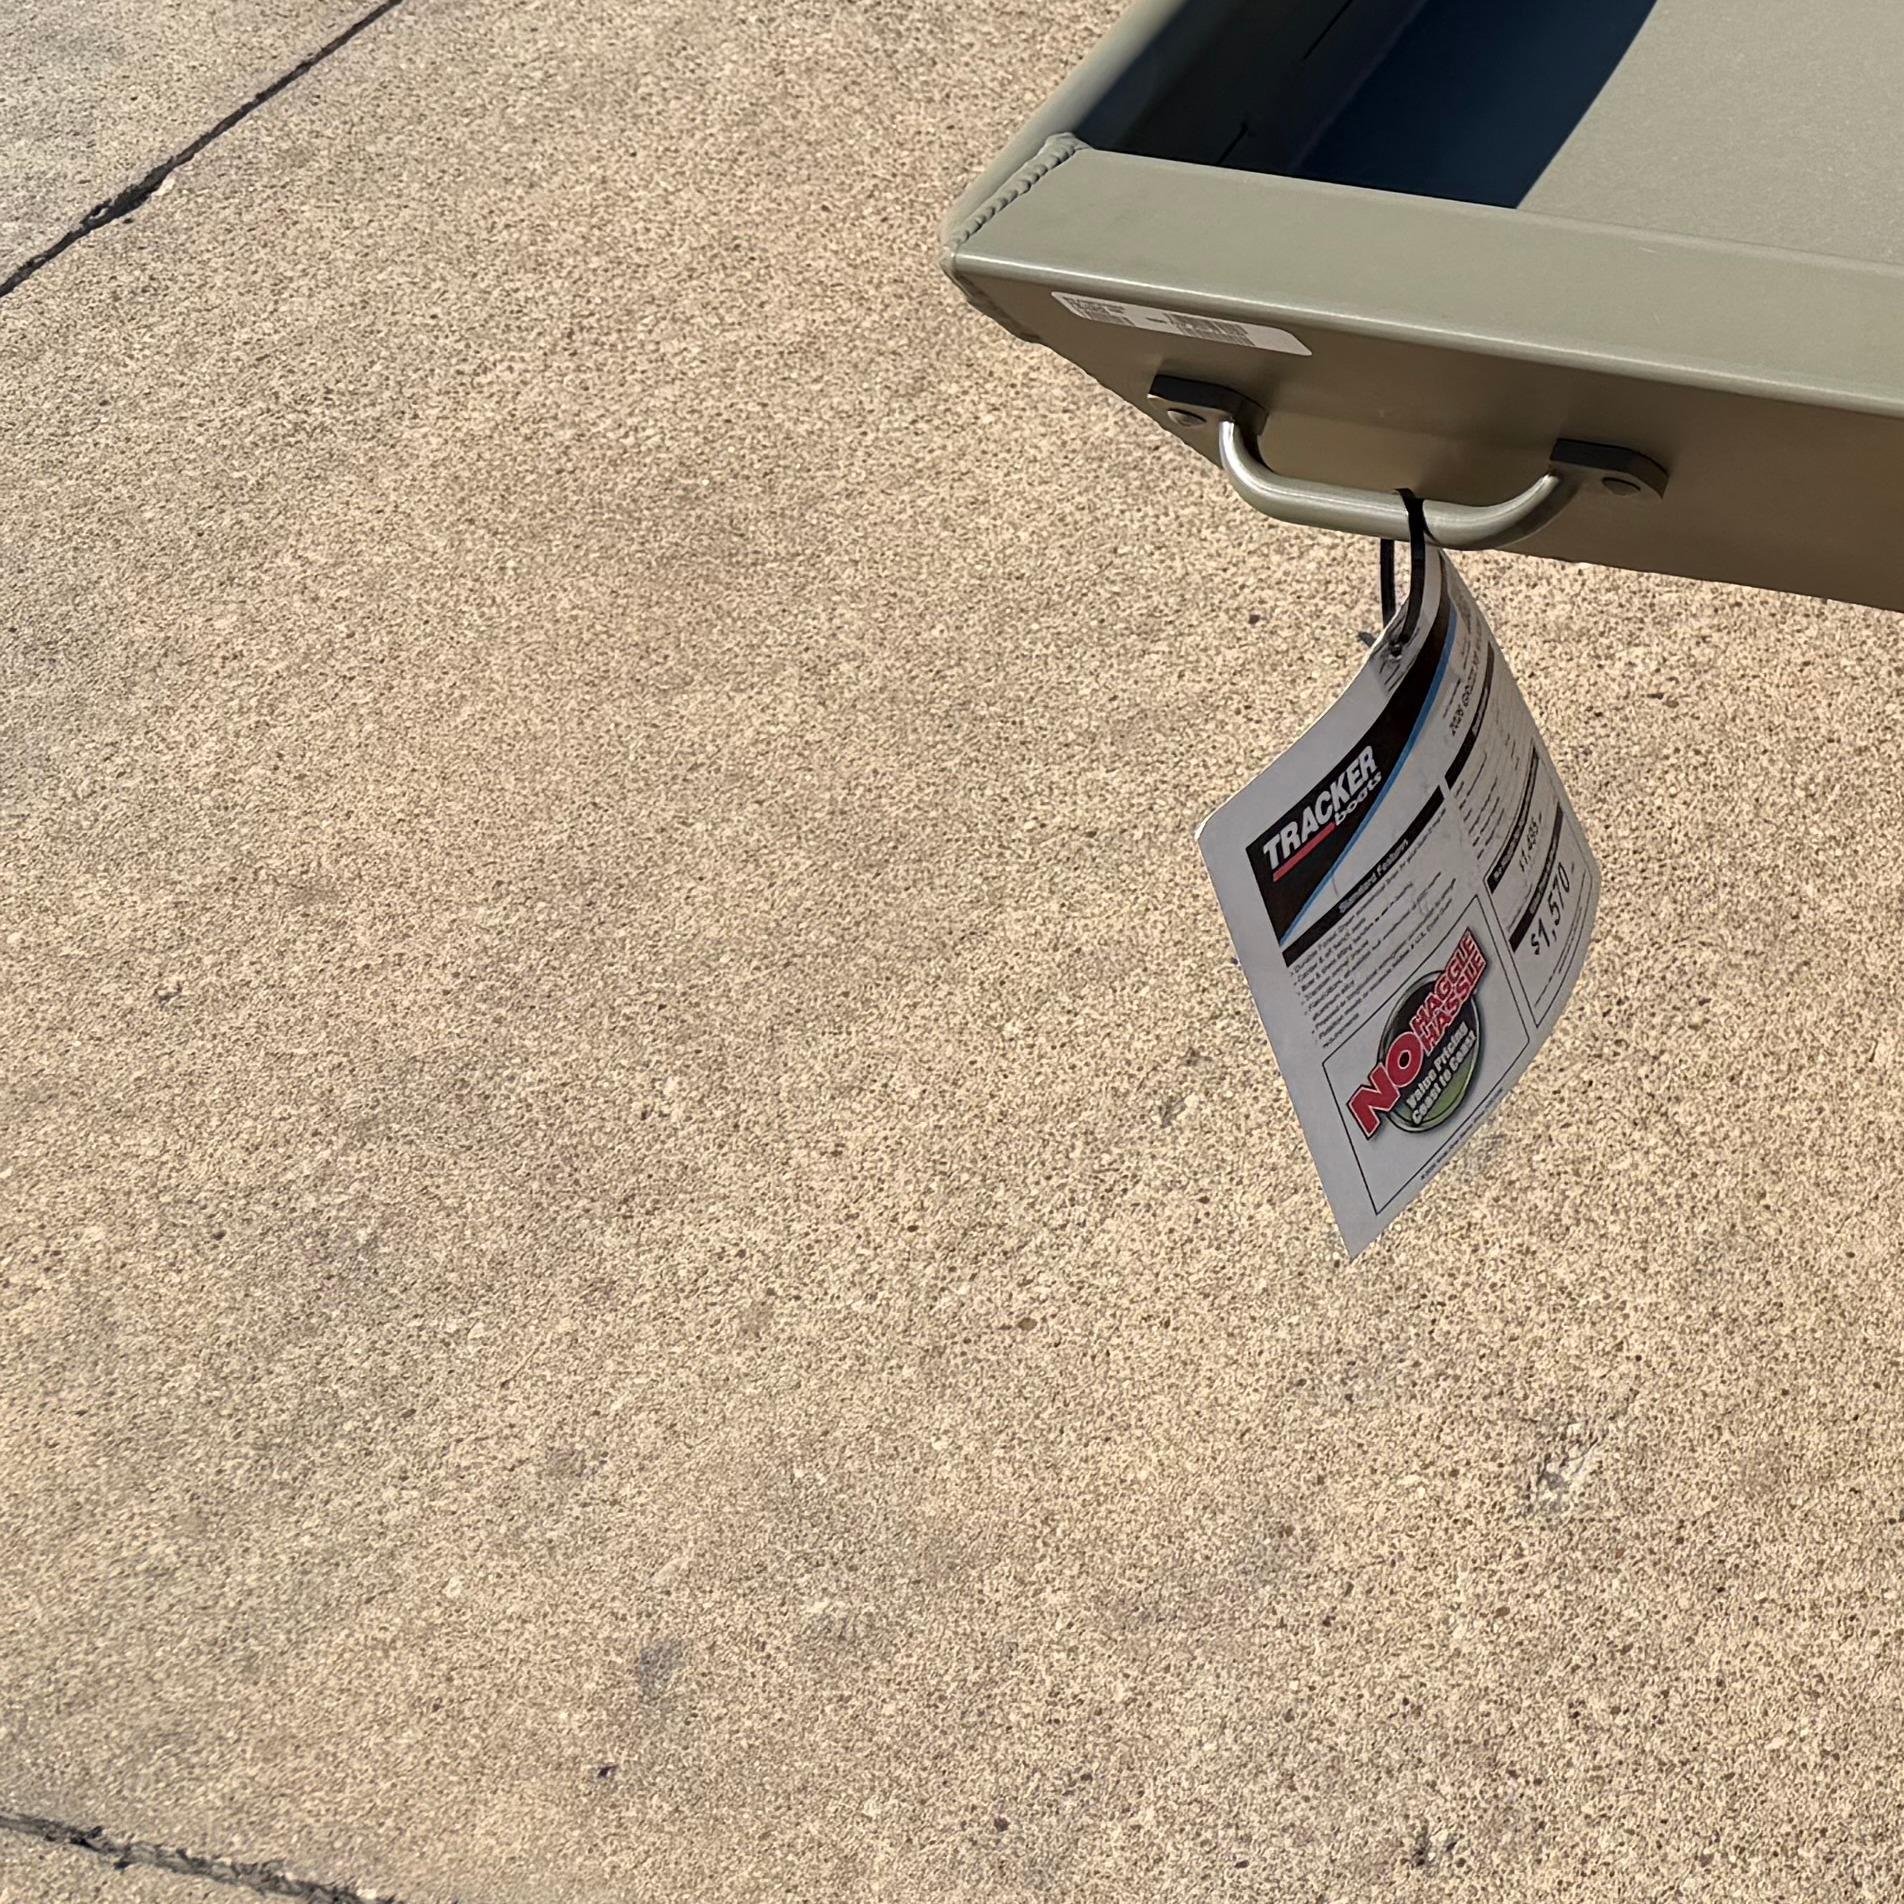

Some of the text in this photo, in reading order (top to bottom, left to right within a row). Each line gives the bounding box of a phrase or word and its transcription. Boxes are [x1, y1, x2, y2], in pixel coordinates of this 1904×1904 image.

[1263, 745, 1378, 870] TRACKER
[1334, 771, 1382, 826] boats
[1410, 929, 1476, 1034] HAGGLE
[1421, 953, 1486, 1056] HASSLE
[1349, 1031, 1424, 1138] NO
[1406, 1072, 1438, 1110] Value
[1434, 1022, 1469, 1072] Pricing
[1412, 1030, 1477, 1125] Coast to Coast
